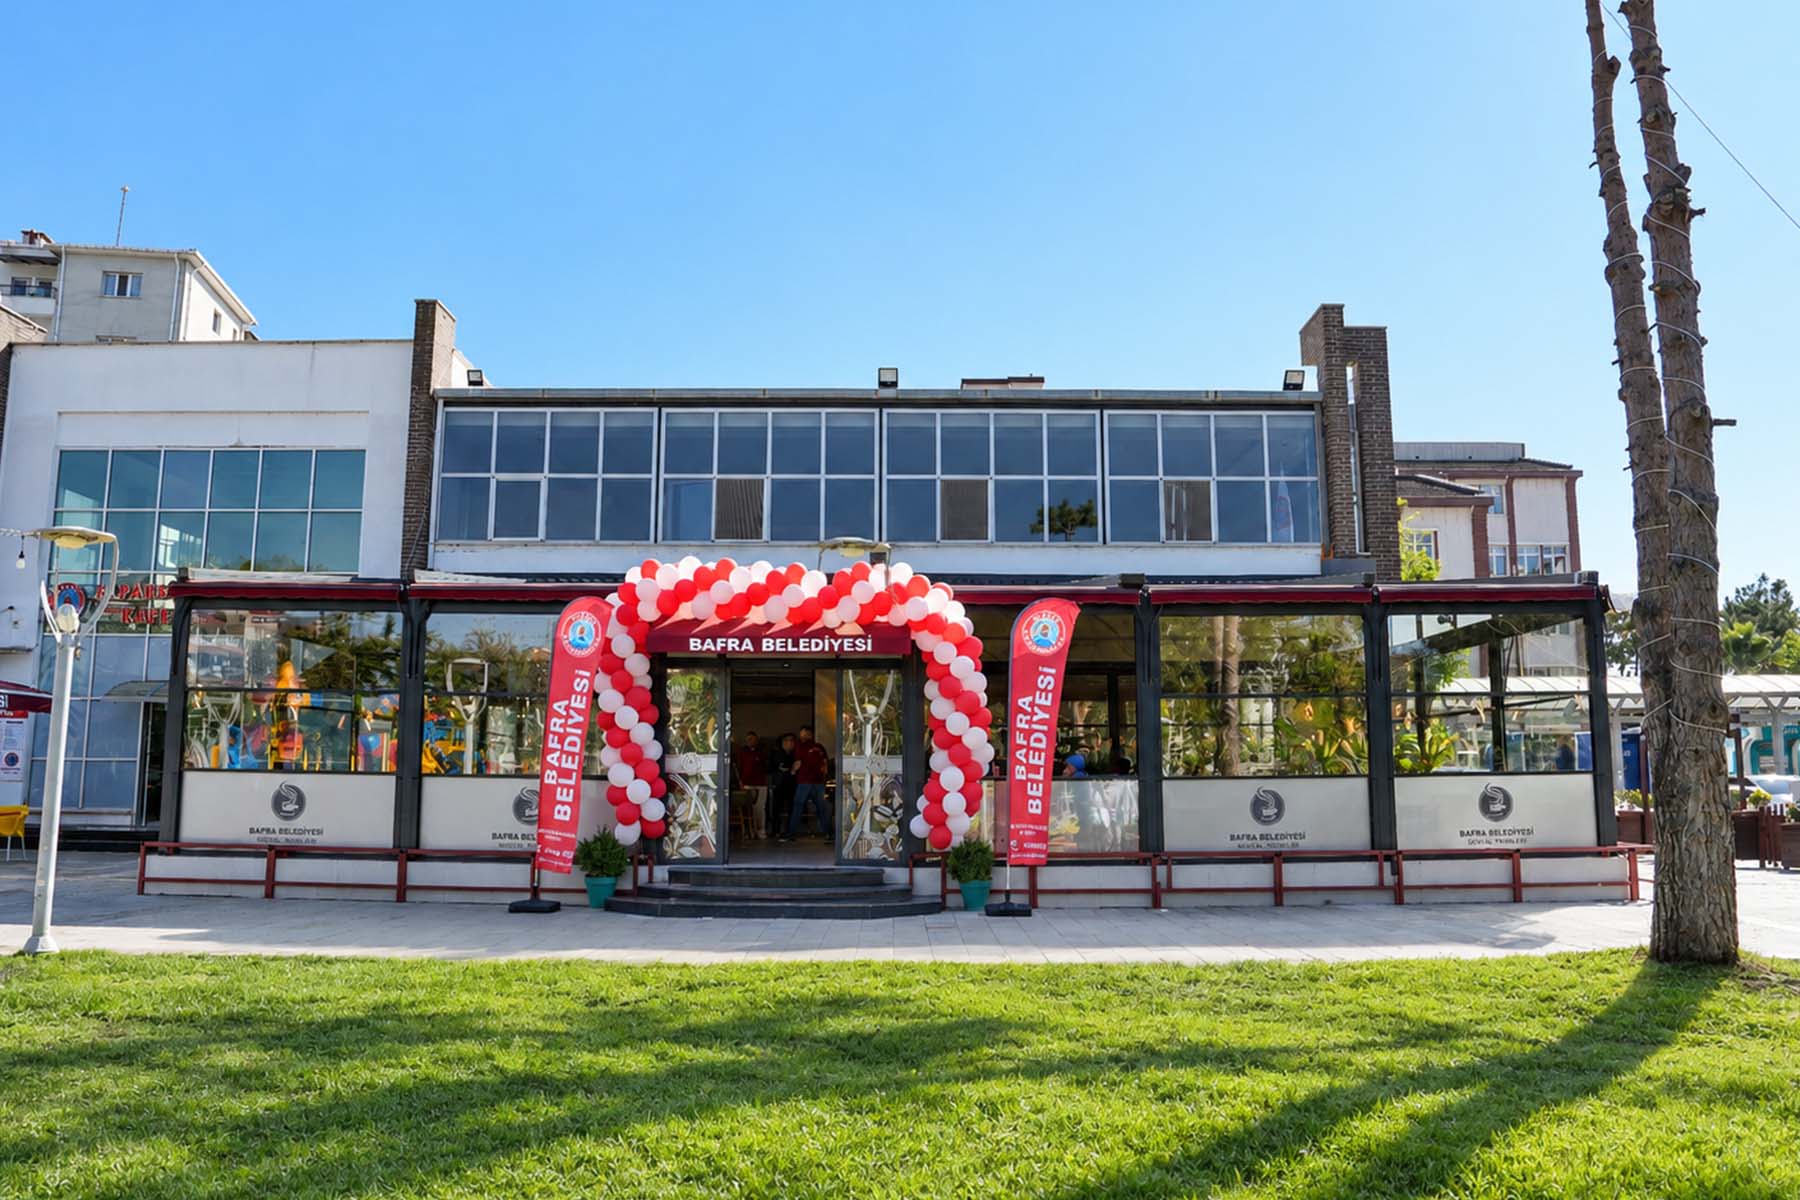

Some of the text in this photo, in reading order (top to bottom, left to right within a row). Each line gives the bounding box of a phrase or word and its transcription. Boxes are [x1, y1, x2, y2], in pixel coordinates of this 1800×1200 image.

[689, 634, 872, 652] BAFRA BELEDİYESİ
[544, 700, 569, 785] BAFRA
[1015, 696, 1033, 780] BAFRA
